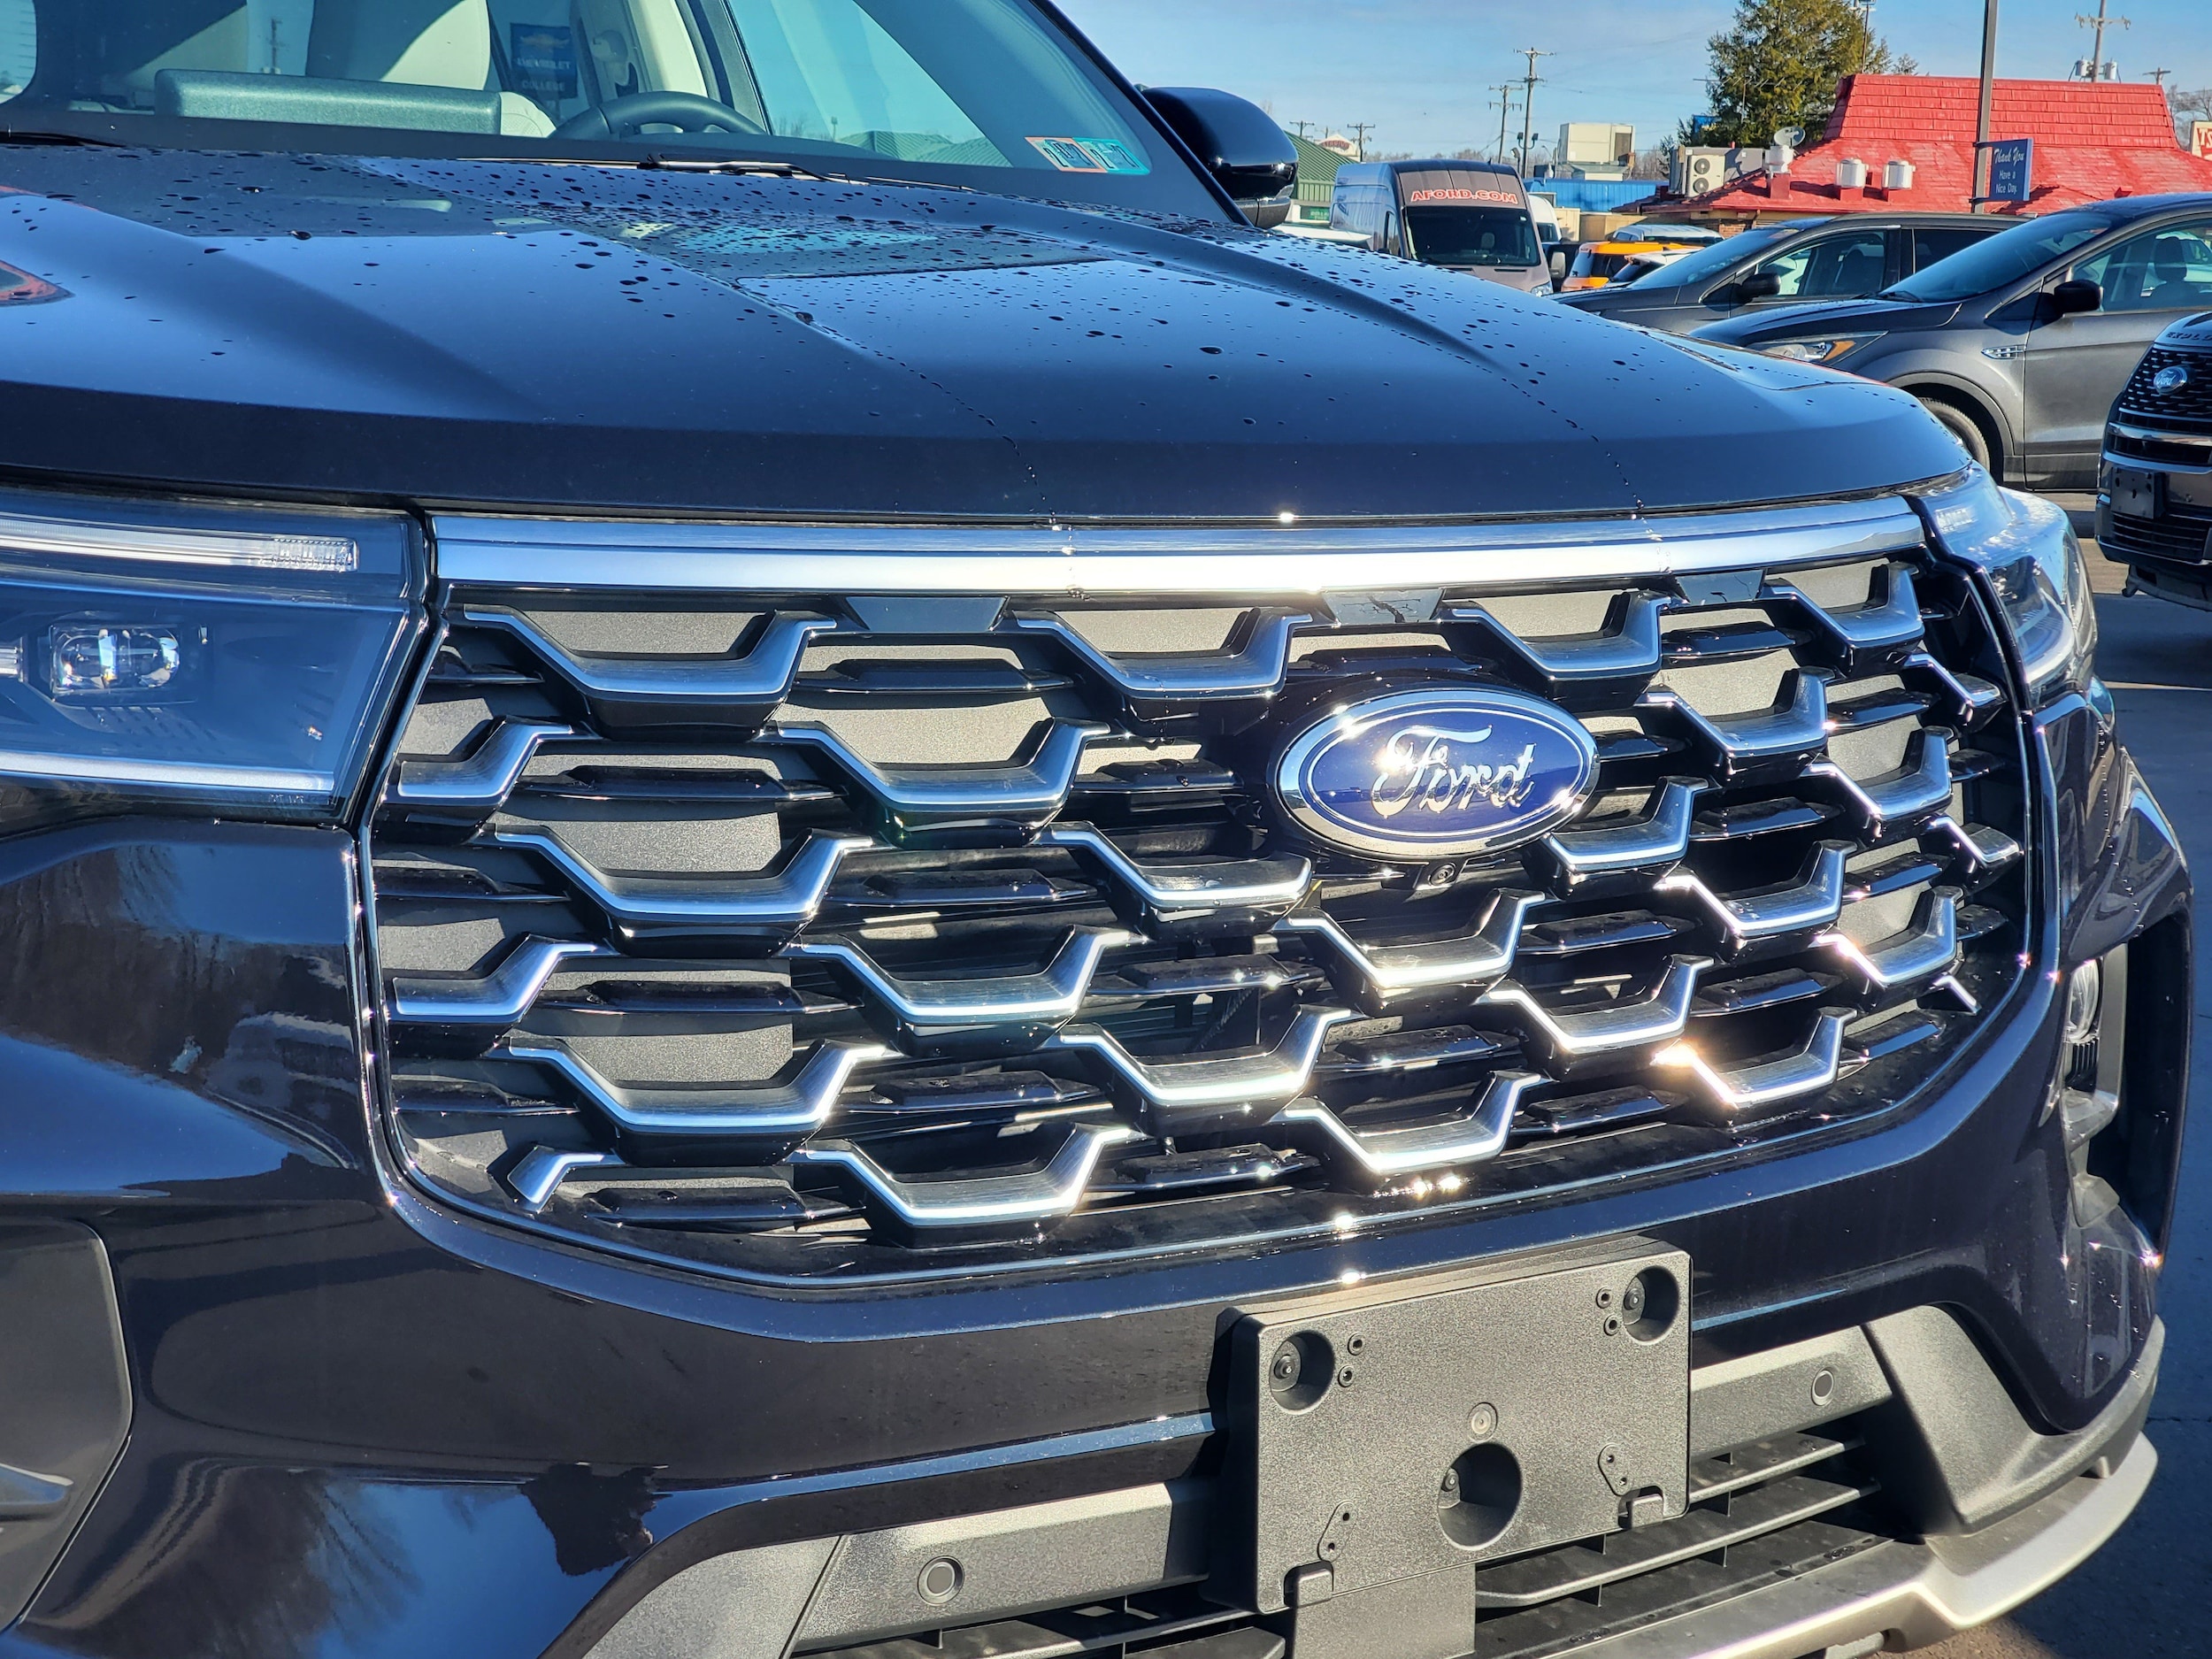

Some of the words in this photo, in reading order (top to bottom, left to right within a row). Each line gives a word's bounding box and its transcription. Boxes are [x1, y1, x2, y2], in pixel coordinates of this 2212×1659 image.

[1993, 148, 2012, 165] Thank
[2012, 146, 2025, 166] You
[1410, 188, 1518, 204] AFORD.COM
[1995, 183, 2007, 194] Nice
[1371, 725, 1537, 819] Ford
